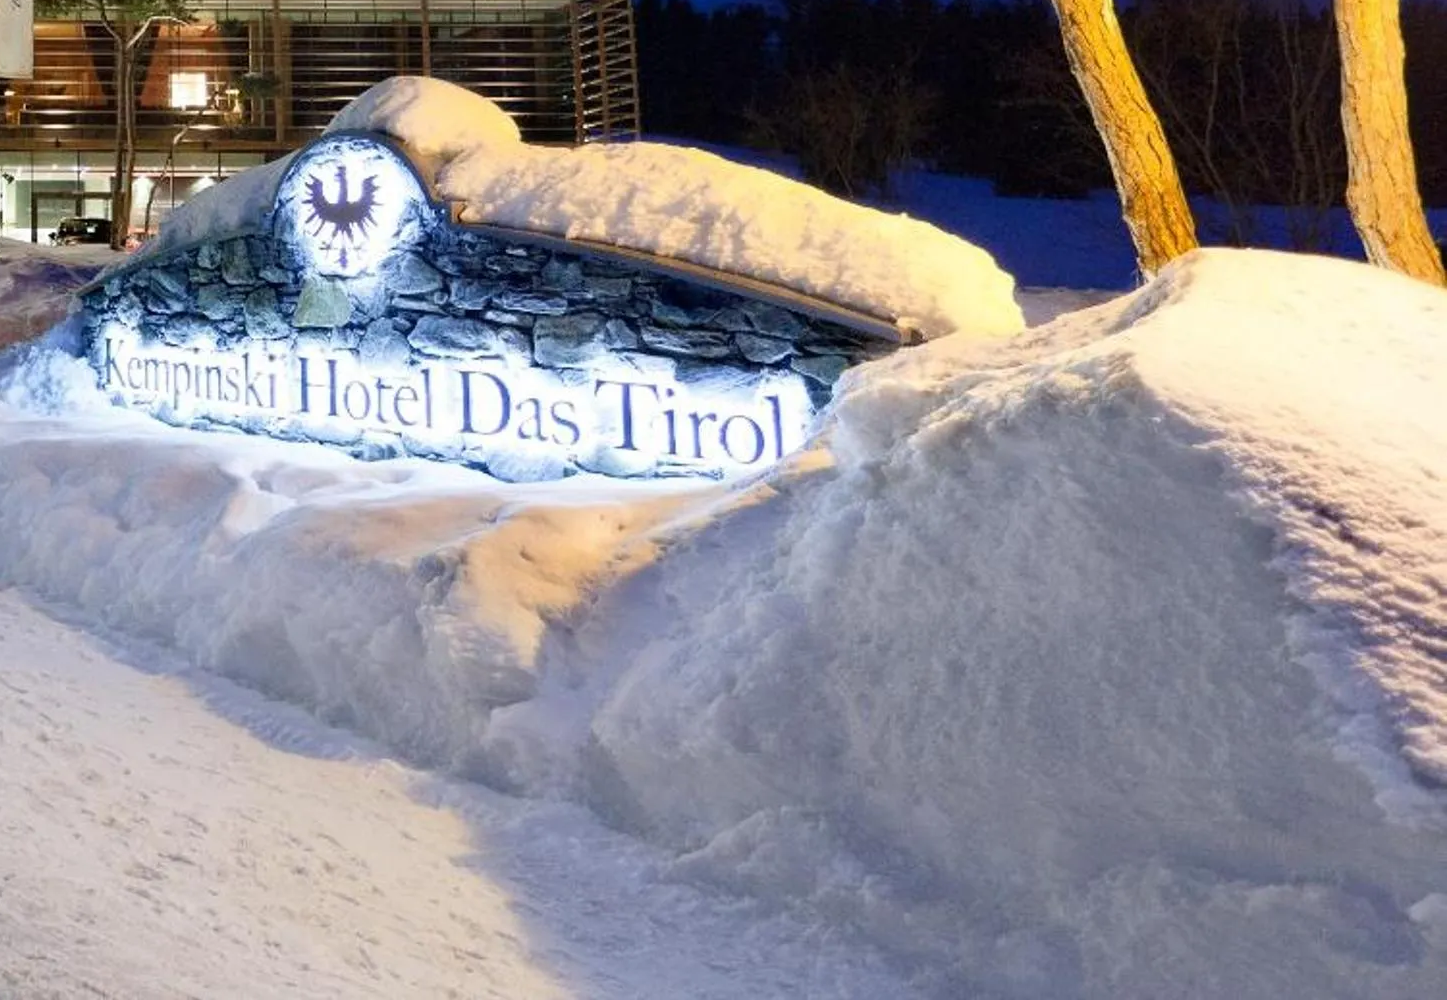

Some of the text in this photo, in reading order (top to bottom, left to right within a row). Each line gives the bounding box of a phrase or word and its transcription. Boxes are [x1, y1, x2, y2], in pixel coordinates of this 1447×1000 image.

[104, 337, 785, 466] Kempinski Hotel Das Tirol
